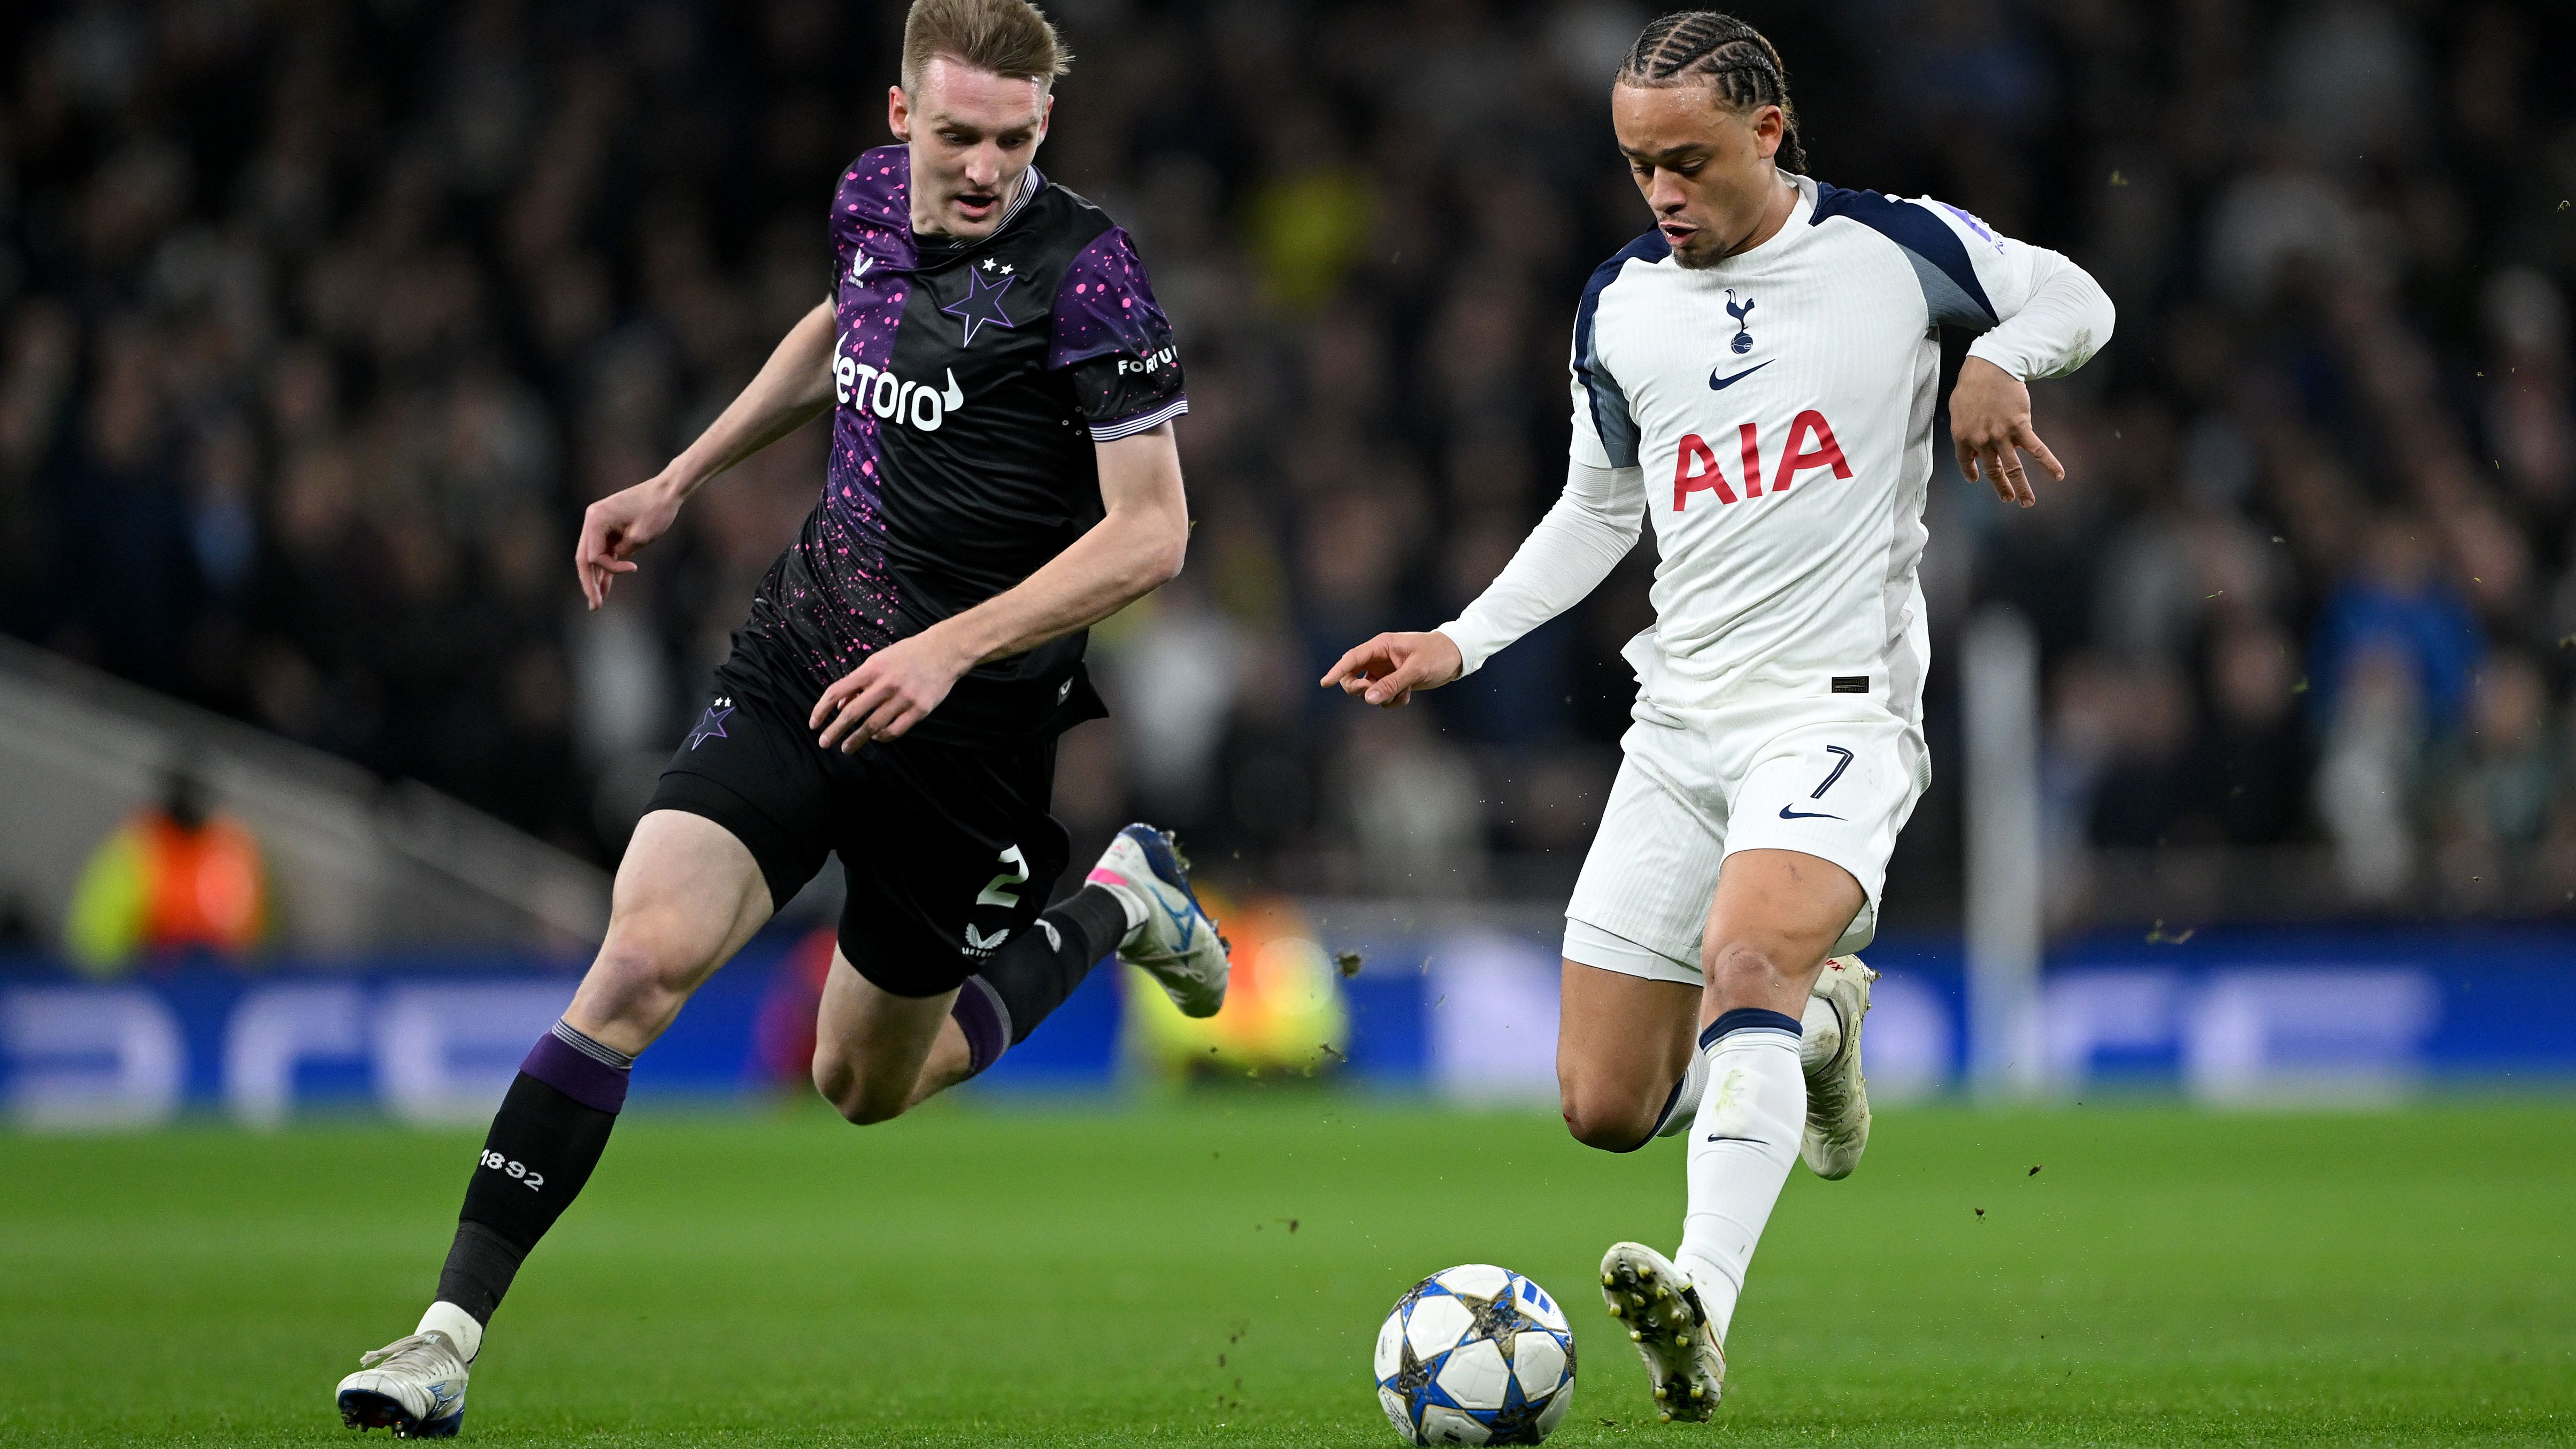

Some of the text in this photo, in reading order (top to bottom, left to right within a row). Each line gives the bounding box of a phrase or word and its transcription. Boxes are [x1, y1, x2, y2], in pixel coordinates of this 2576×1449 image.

[1672, 410, 1853, 512] AIA
[1810, 744, 1855, 799] 7
[976, 843, 1029, 908] 2
[480, 1149, 544, 1192] 1892
